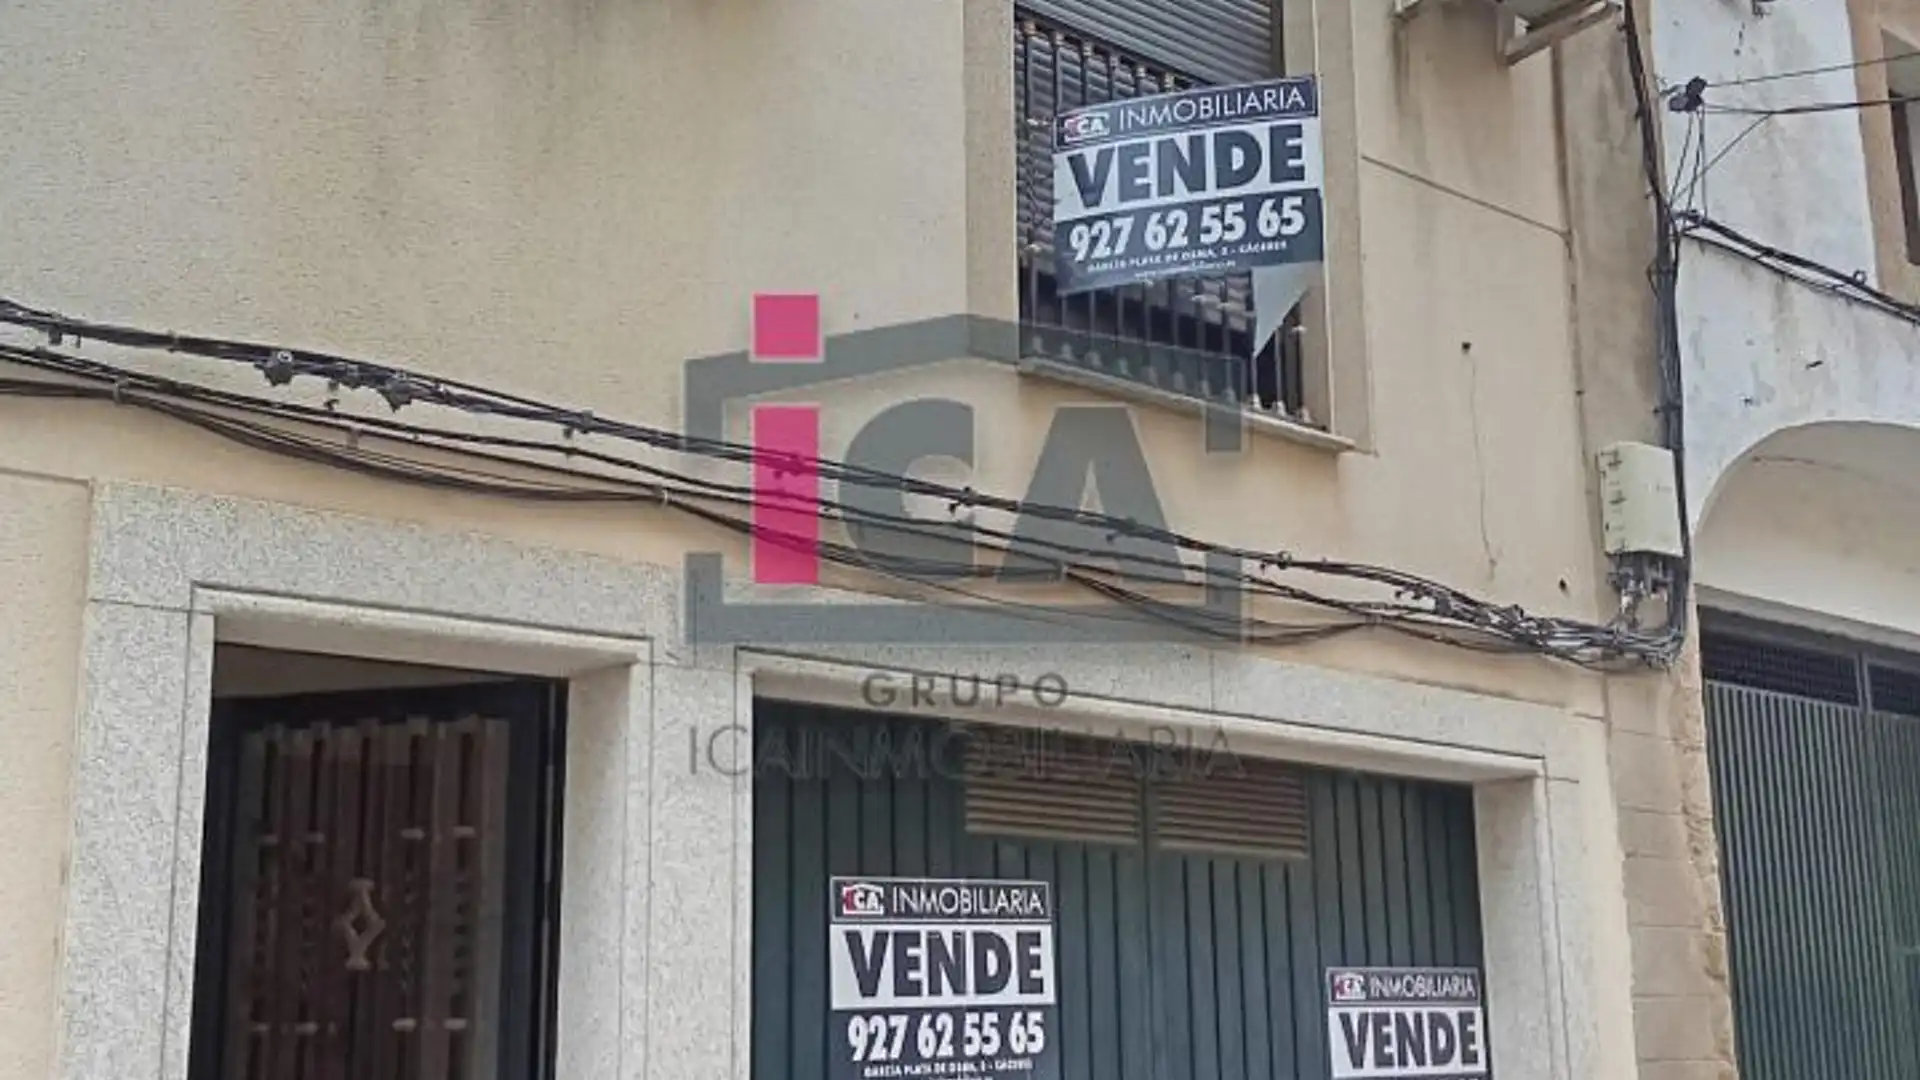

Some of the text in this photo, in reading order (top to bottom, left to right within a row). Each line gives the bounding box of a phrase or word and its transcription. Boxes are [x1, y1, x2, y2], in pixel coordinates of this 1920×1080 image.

[1119, 86, 1306, 131] INMOBILIARIA
[1067, 123, 1306, 208] VENDE
[1069, 196, 1305, 262] 927 62 55 65
[892, 886, 1044, 914] INMOBILIARIA
[844, 930, 1045, 998] VENDE
[1370, 975, 1475, 998] INMOBILIARIA
[848, 1011, 1045, 1061] 927 62 55 65
[1339, 1011, 1479, 1069] VENDE
